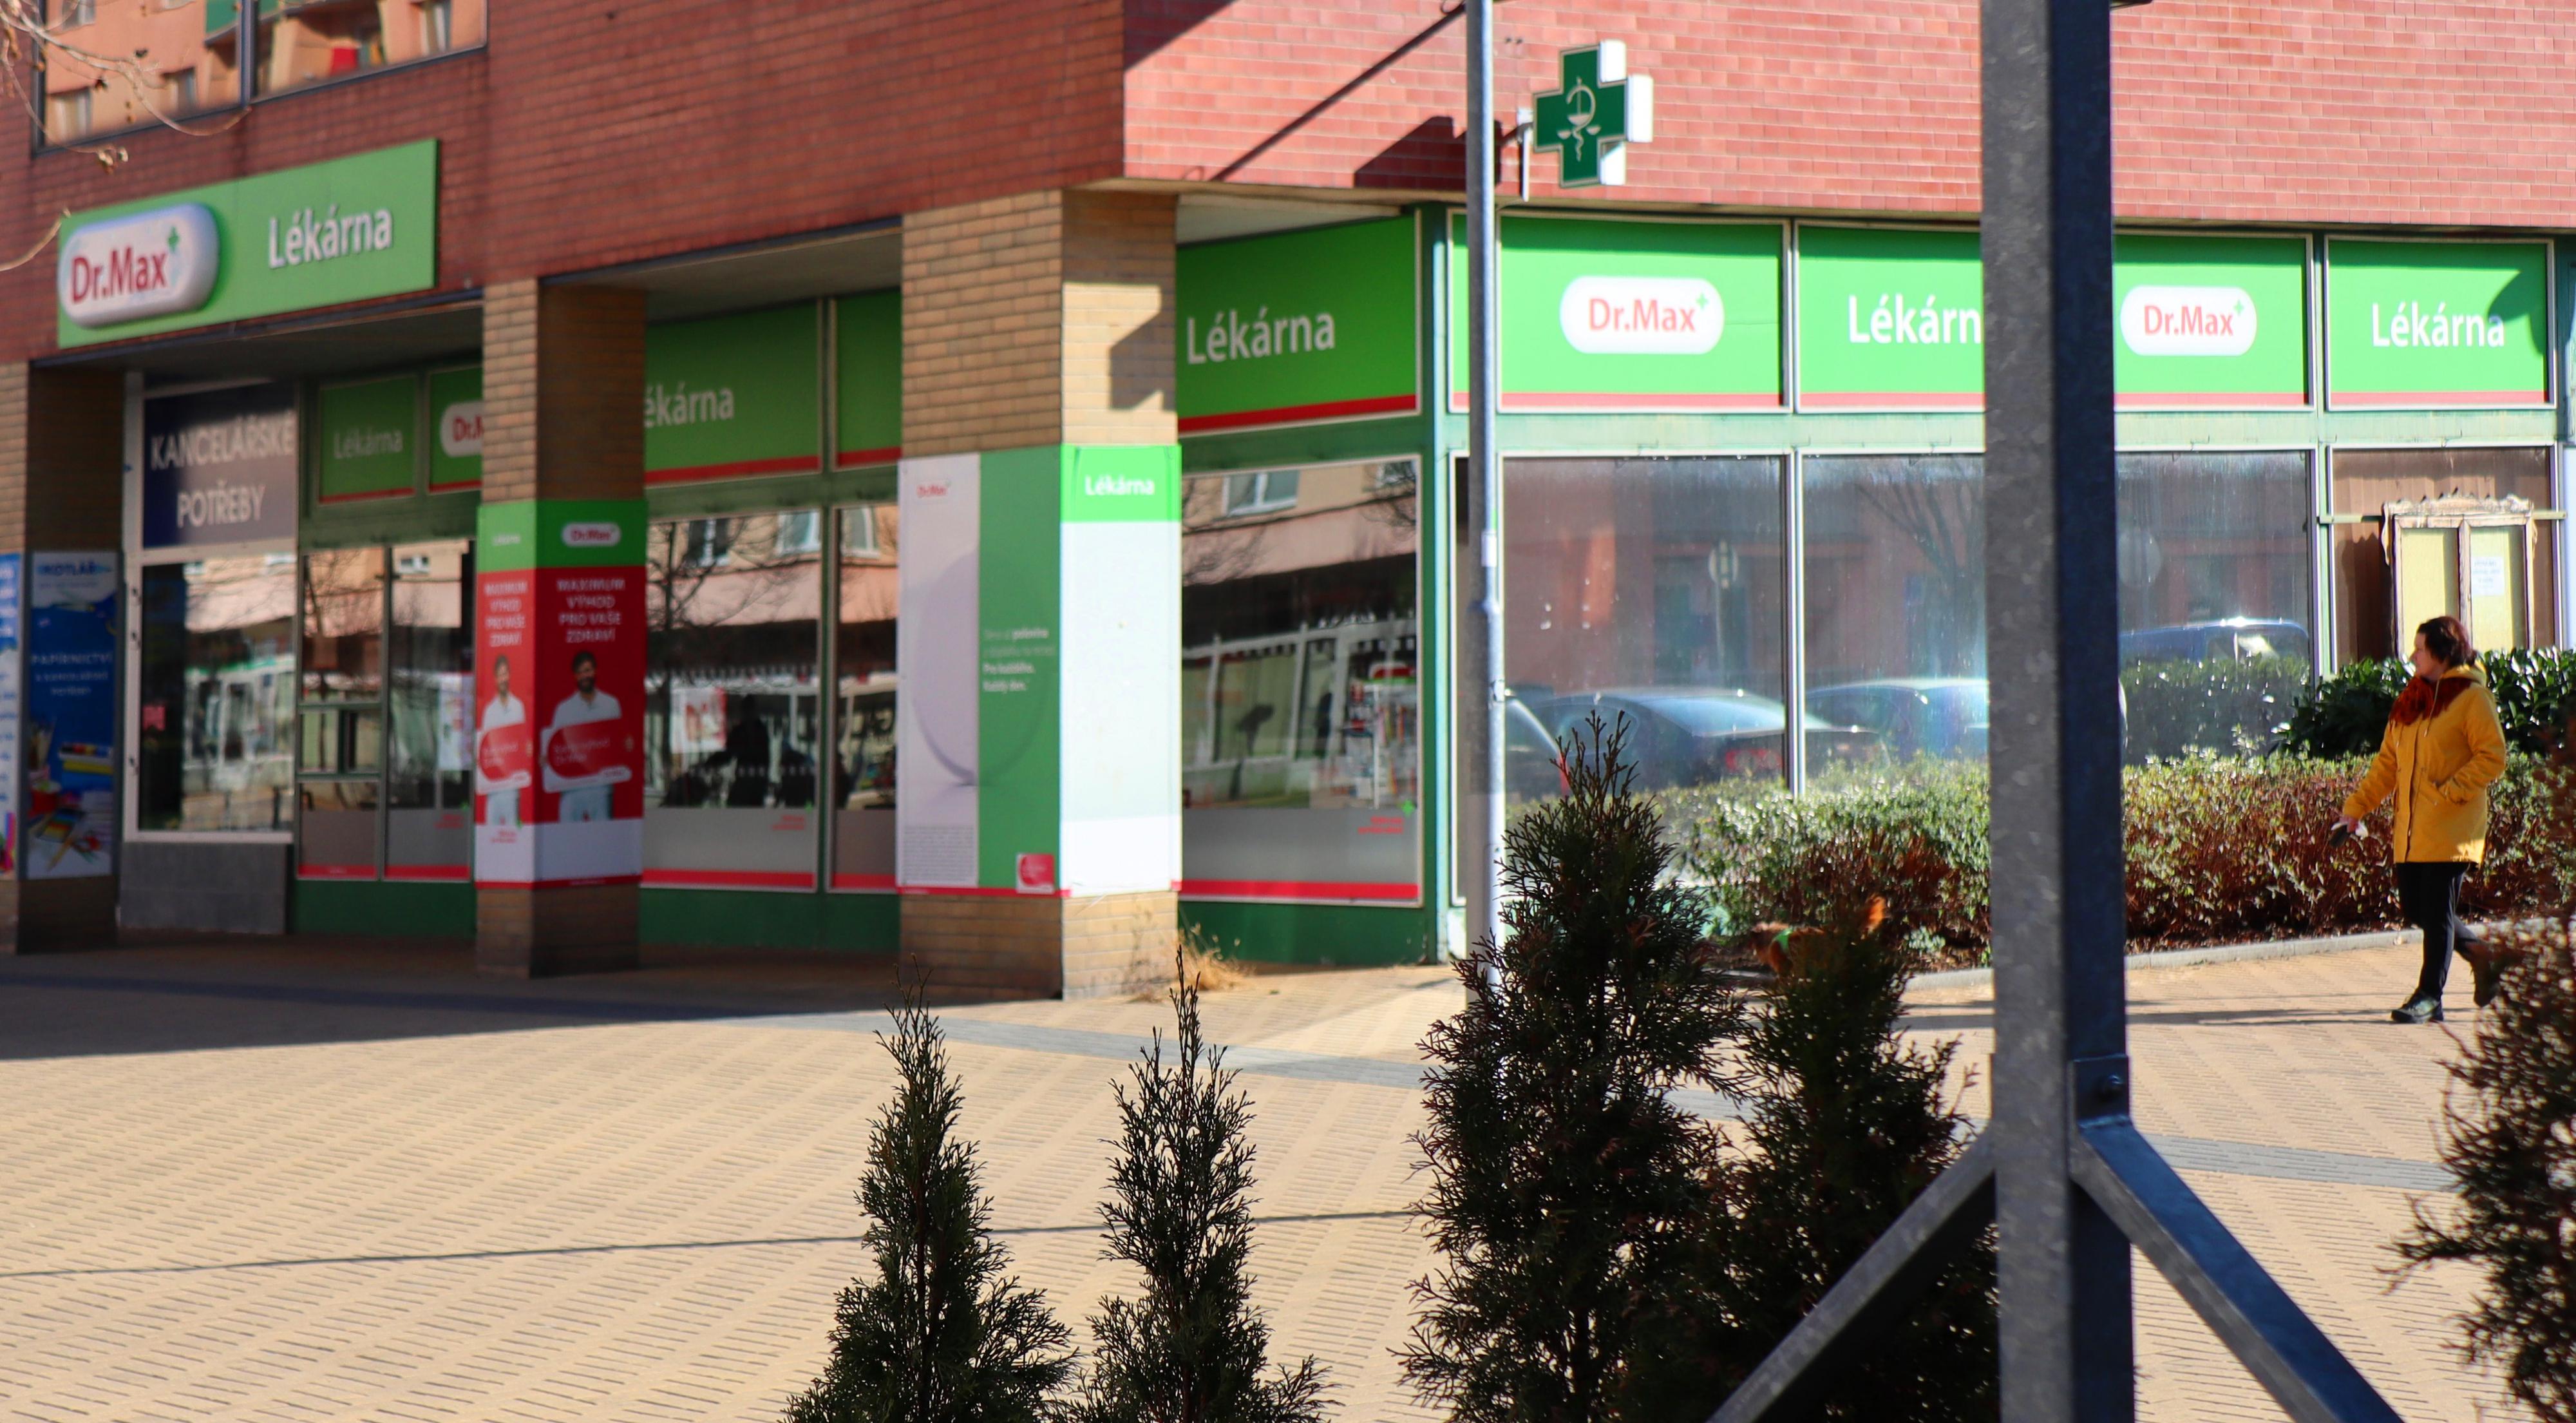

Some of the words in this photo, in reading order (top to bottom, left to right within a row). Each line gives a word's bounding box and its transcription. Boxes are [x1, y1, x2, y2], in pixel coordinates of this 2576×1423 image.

[269, 205, 392, 269] Lékárna
[71, 247, 167, 304] Dr.Max
[1589, 298, 1696, 332] Dr.Max
[1848, 292, 1983, 344] Lékárn
[2144, 305, 2233, 336] Dr.Max
[2372, 301, 2504, 347] Lékárna
[1187, 305, 1336, 365] Lékárna
[644, 381, 734, 428] ékárna
[151, 410, 298, 471] KANCELÁŘSKÉ
[333, 426, 403, 459] Lékárna
[1084, 474, 1155, 495] Lékárna
[177, 479, 266, 528] POTŘEBY
[571, 528, 612, 542] Dr.Max
[556, 578, 626, 591] MAXIMUM
[566, 594, 616, 609] VÝHOD
[559, 612, 587, 626] PRO
[589, 609, 622, 626] VAŠE
[566, 627, 616, 644] ZDRAVÍ
